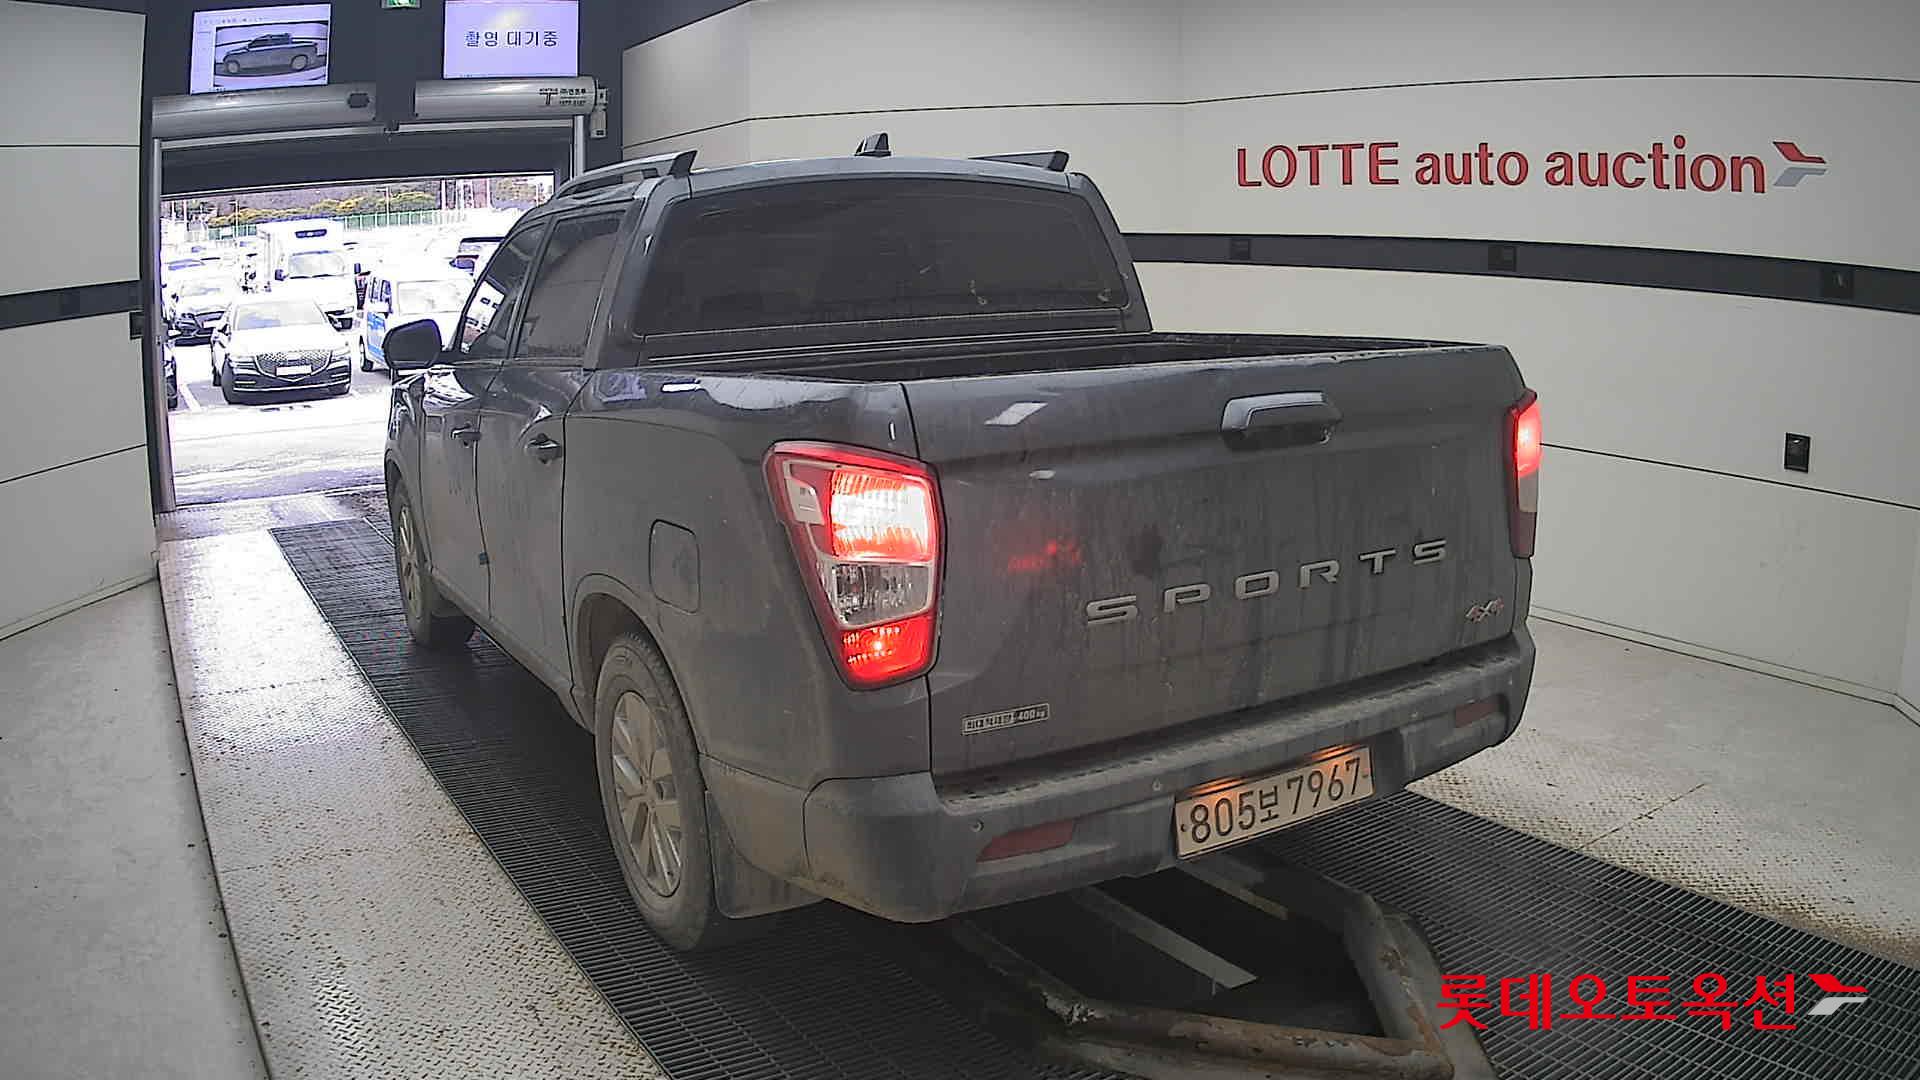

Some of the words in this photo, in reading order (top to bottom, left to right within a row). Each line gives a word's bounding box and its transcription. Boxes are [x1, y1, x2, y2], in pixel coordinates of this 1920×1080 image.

[465, 31, 498, 48] 촬영
[507, 31, 559, 48] 대기중
[1237, 142, 1400, 187] LOTTE
[1415, 142, 1529, 186] auto
[1544, 135, 1767, 194] auction
[1085, 539, 1448, 625] SPORTS
